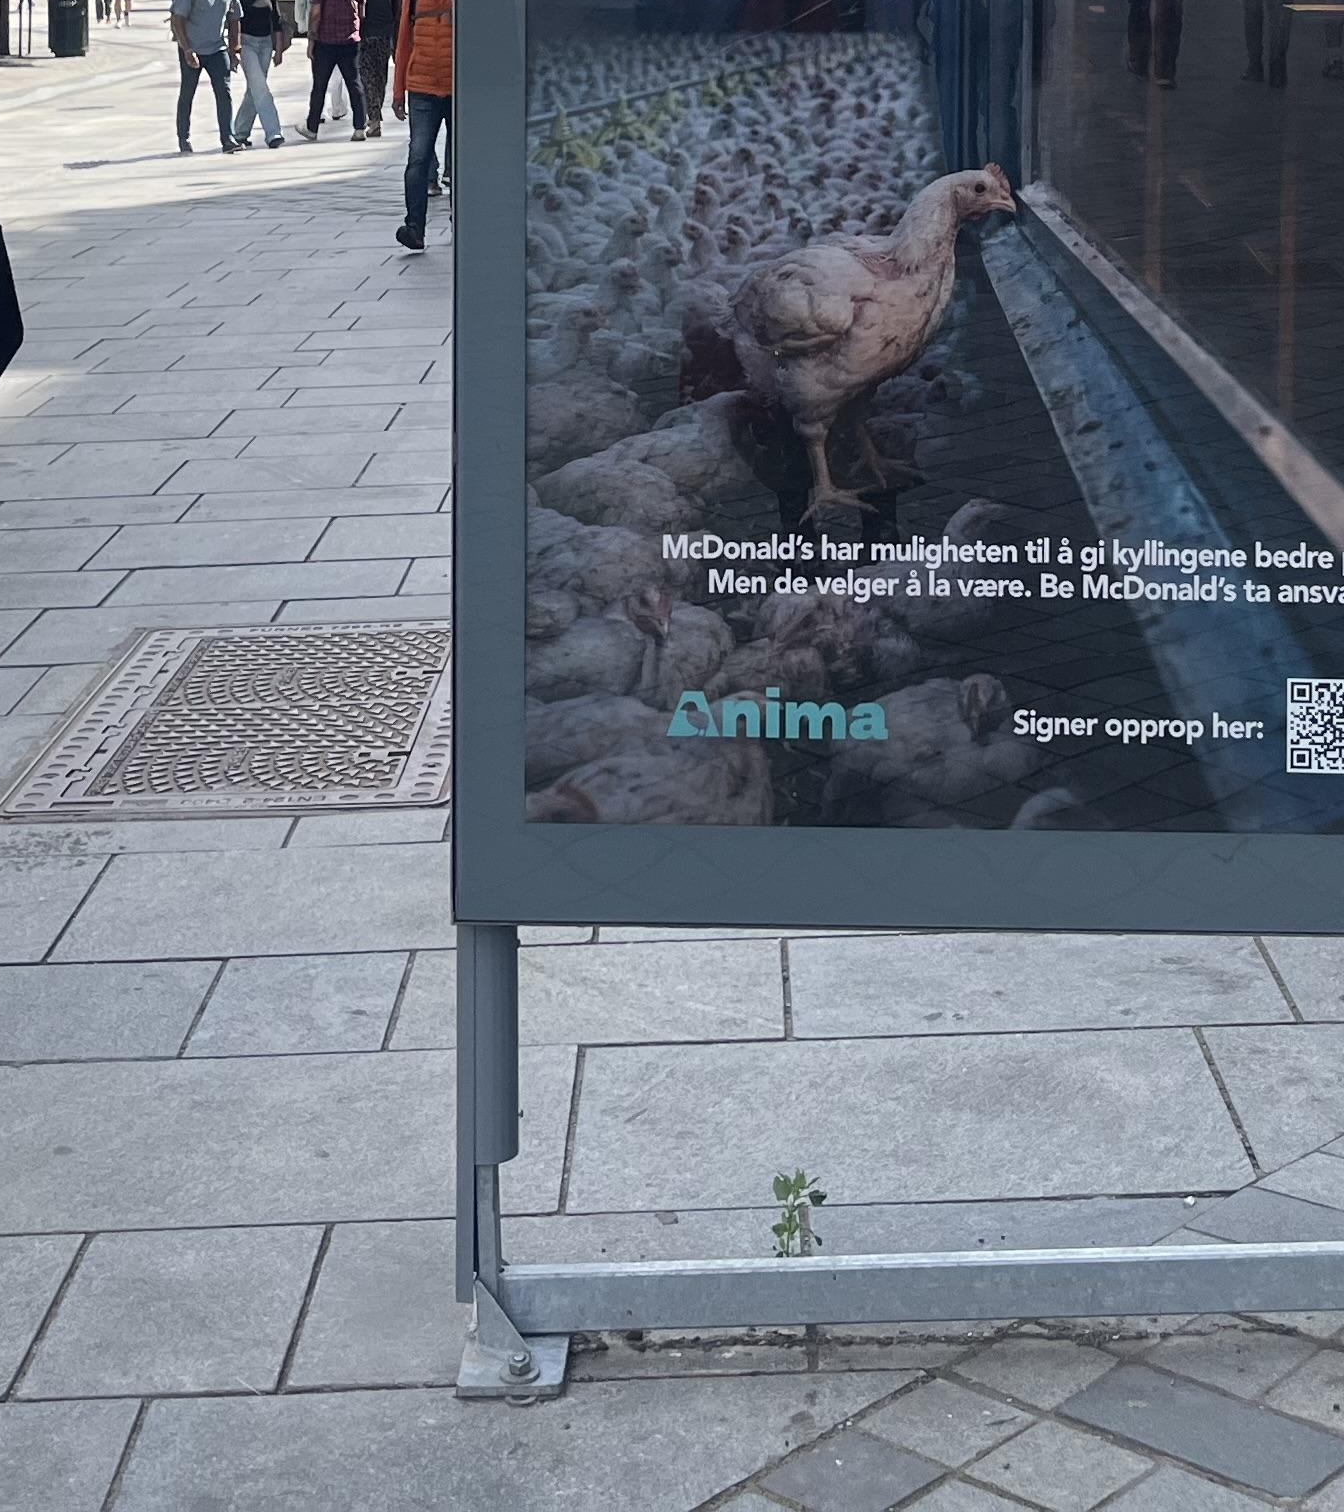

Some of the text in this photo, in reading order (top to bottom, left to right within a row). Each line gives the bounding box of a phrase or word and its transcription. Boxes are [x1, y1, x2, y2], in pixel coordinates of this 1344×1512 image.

[661, 533, 814, 561] McDonald's
[821, 534, 864, 562] har
[870, 535, 1018, 570] muligheten
[1024, 537, 1050, 565] til
[1056, 537, 1074, 565] å
[1080, 539, 1105, 571] gi
[1112, 539, 1248, 574] kyllingene
[1255, 541, 1335, 570] bedre
[708, 568, 767, 594] Men
[773, 568, 808, 595] de
[814, 568, 899, 603] velger
[905, 569, 922, 597] å
[927, 569, 951, 597] la
[957, 575, 1032, 598] være.
[1039, 573, 1075, 599] Be
[1081, 574, 1237, 603] McDonald's
[1242, 578, 1271, 603] ta
[666, 686, 889, 740] Anima
[1012, 708, 1264, 745] Signer opprop her:
